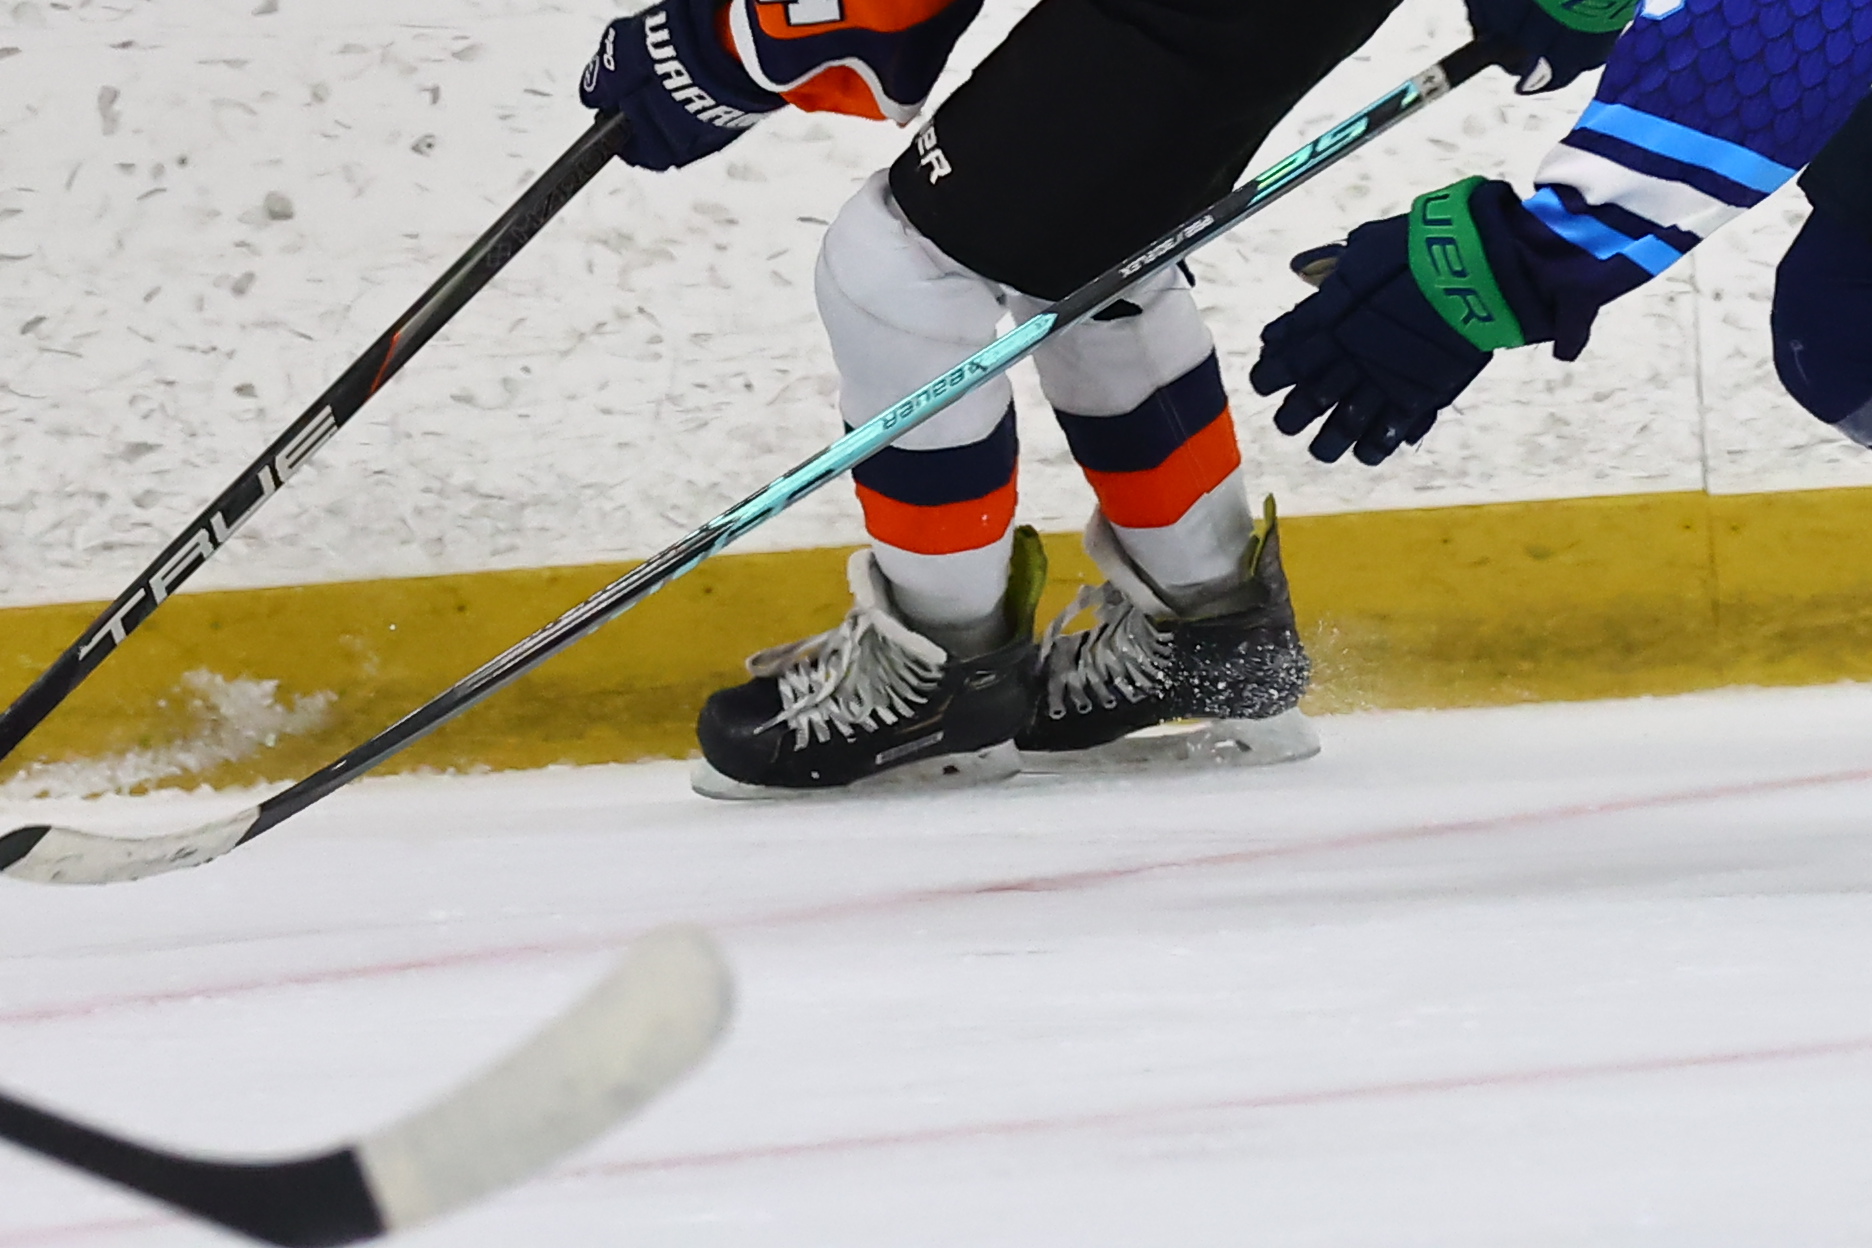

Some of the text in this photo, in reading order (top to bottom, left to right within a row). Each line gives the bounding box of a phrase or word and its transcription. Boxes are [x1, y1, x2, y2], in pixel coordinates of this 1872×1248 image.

[645, 10, 772, 130] WARR
[1420, 193, 1494, 326] UER
[78, 404, 339, 663] TRUE
